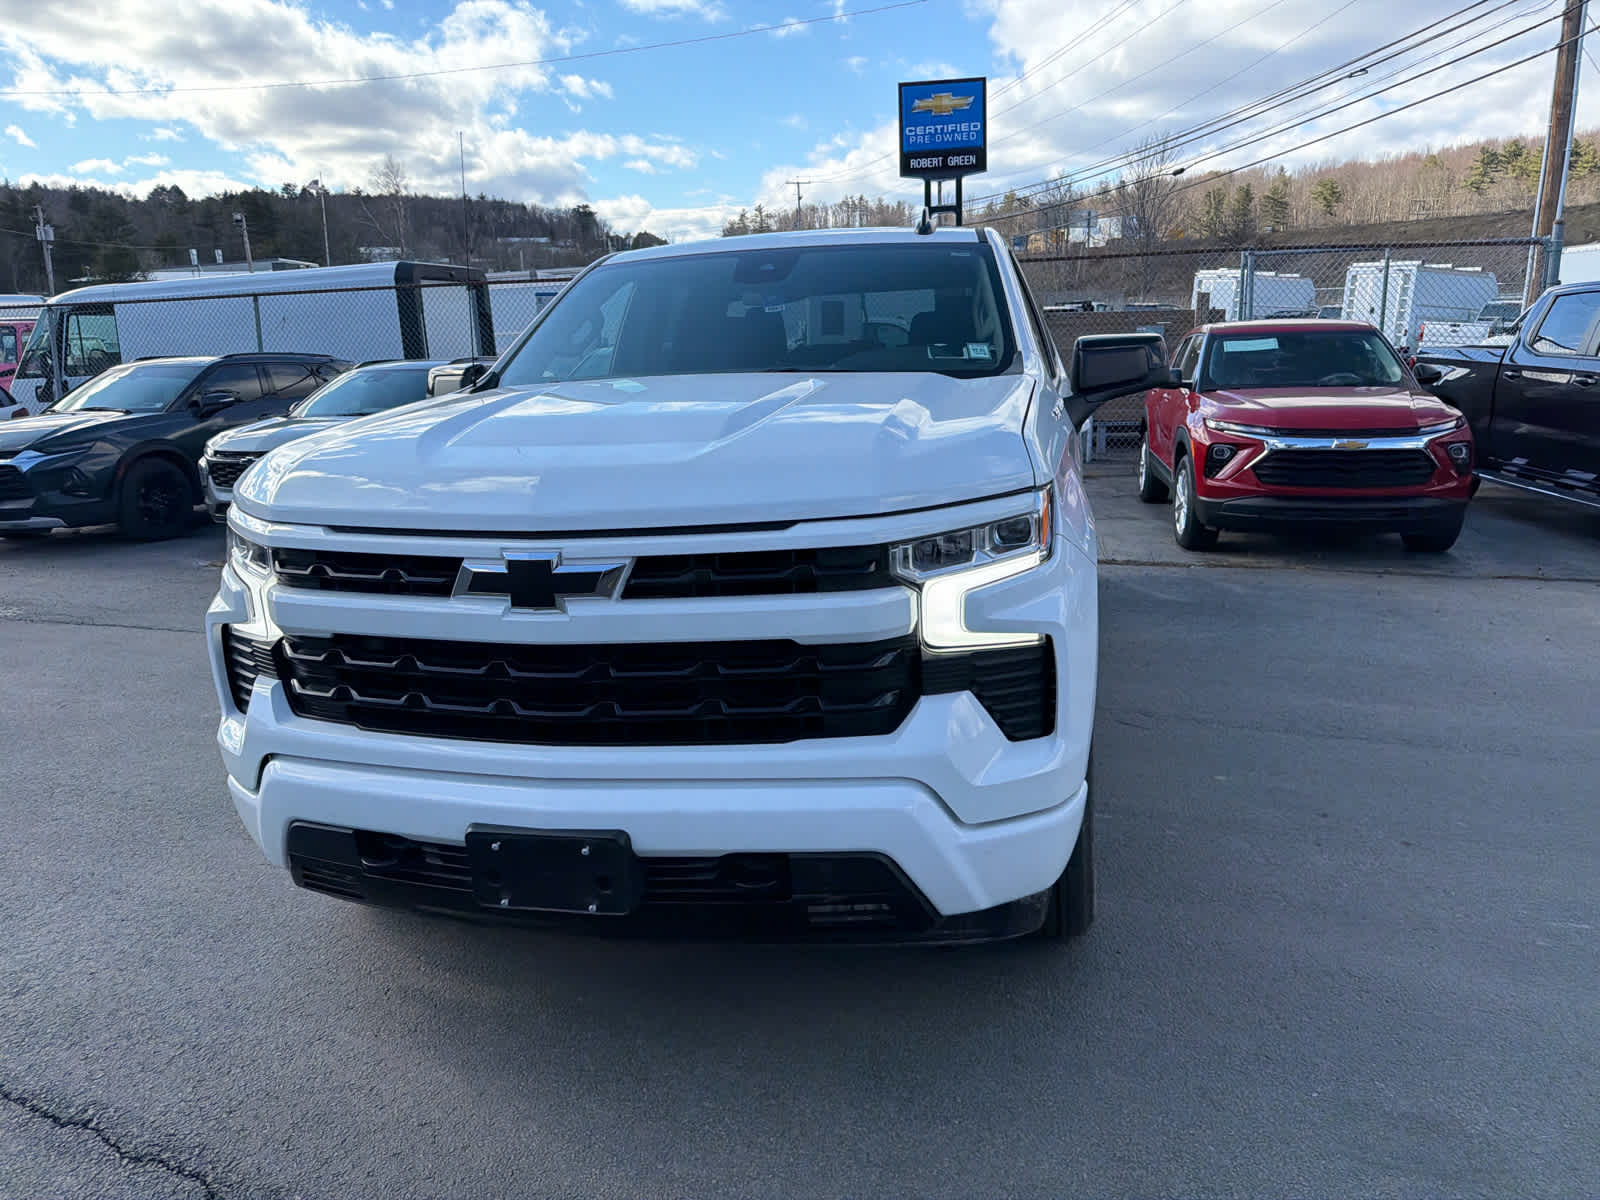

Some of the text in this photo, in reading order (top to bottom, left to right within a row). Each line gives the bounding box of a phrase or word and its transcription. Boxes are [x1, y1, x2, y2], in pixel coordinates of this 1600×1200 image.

[905, 122, 981, 136] CERTIFIED
[909, 131, 977, 145] PRE-OWNED
[910, 155, 976, 169] ROBERT GREEN
